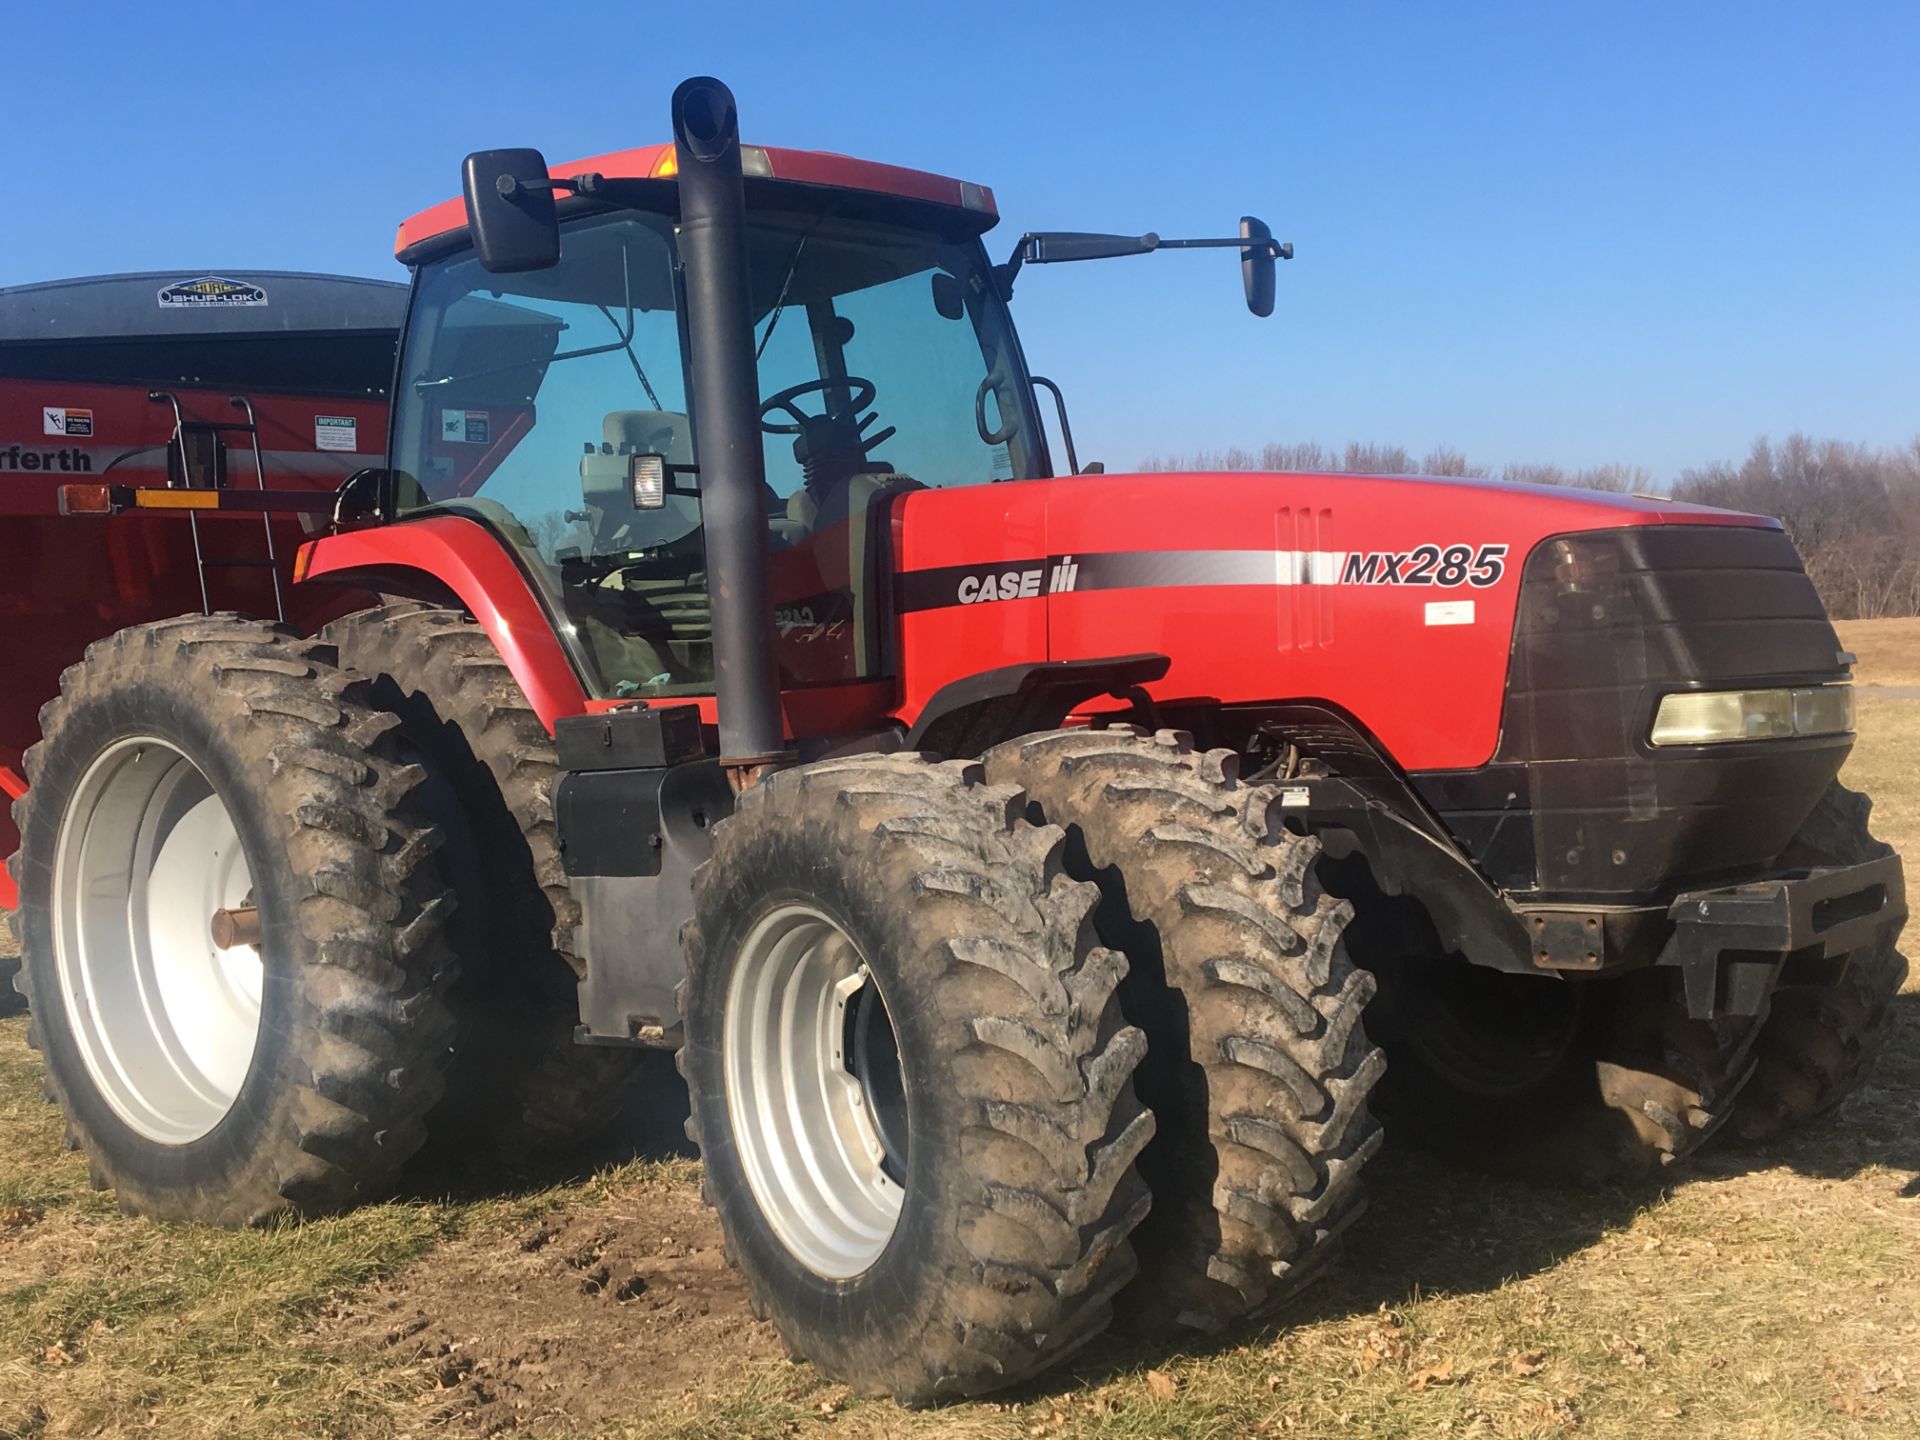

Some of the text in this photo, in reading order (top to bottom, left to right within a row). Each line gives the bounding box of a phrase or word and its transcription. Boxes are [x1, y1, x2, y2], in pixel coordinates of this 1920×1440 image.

[172, 294, 255, 302] SHUR-LOK
[318, 417, 353, 426] IMPORTANT
[1342, 543, 1509, 588] MX285
[957, 569, 1043, 604] CASE
